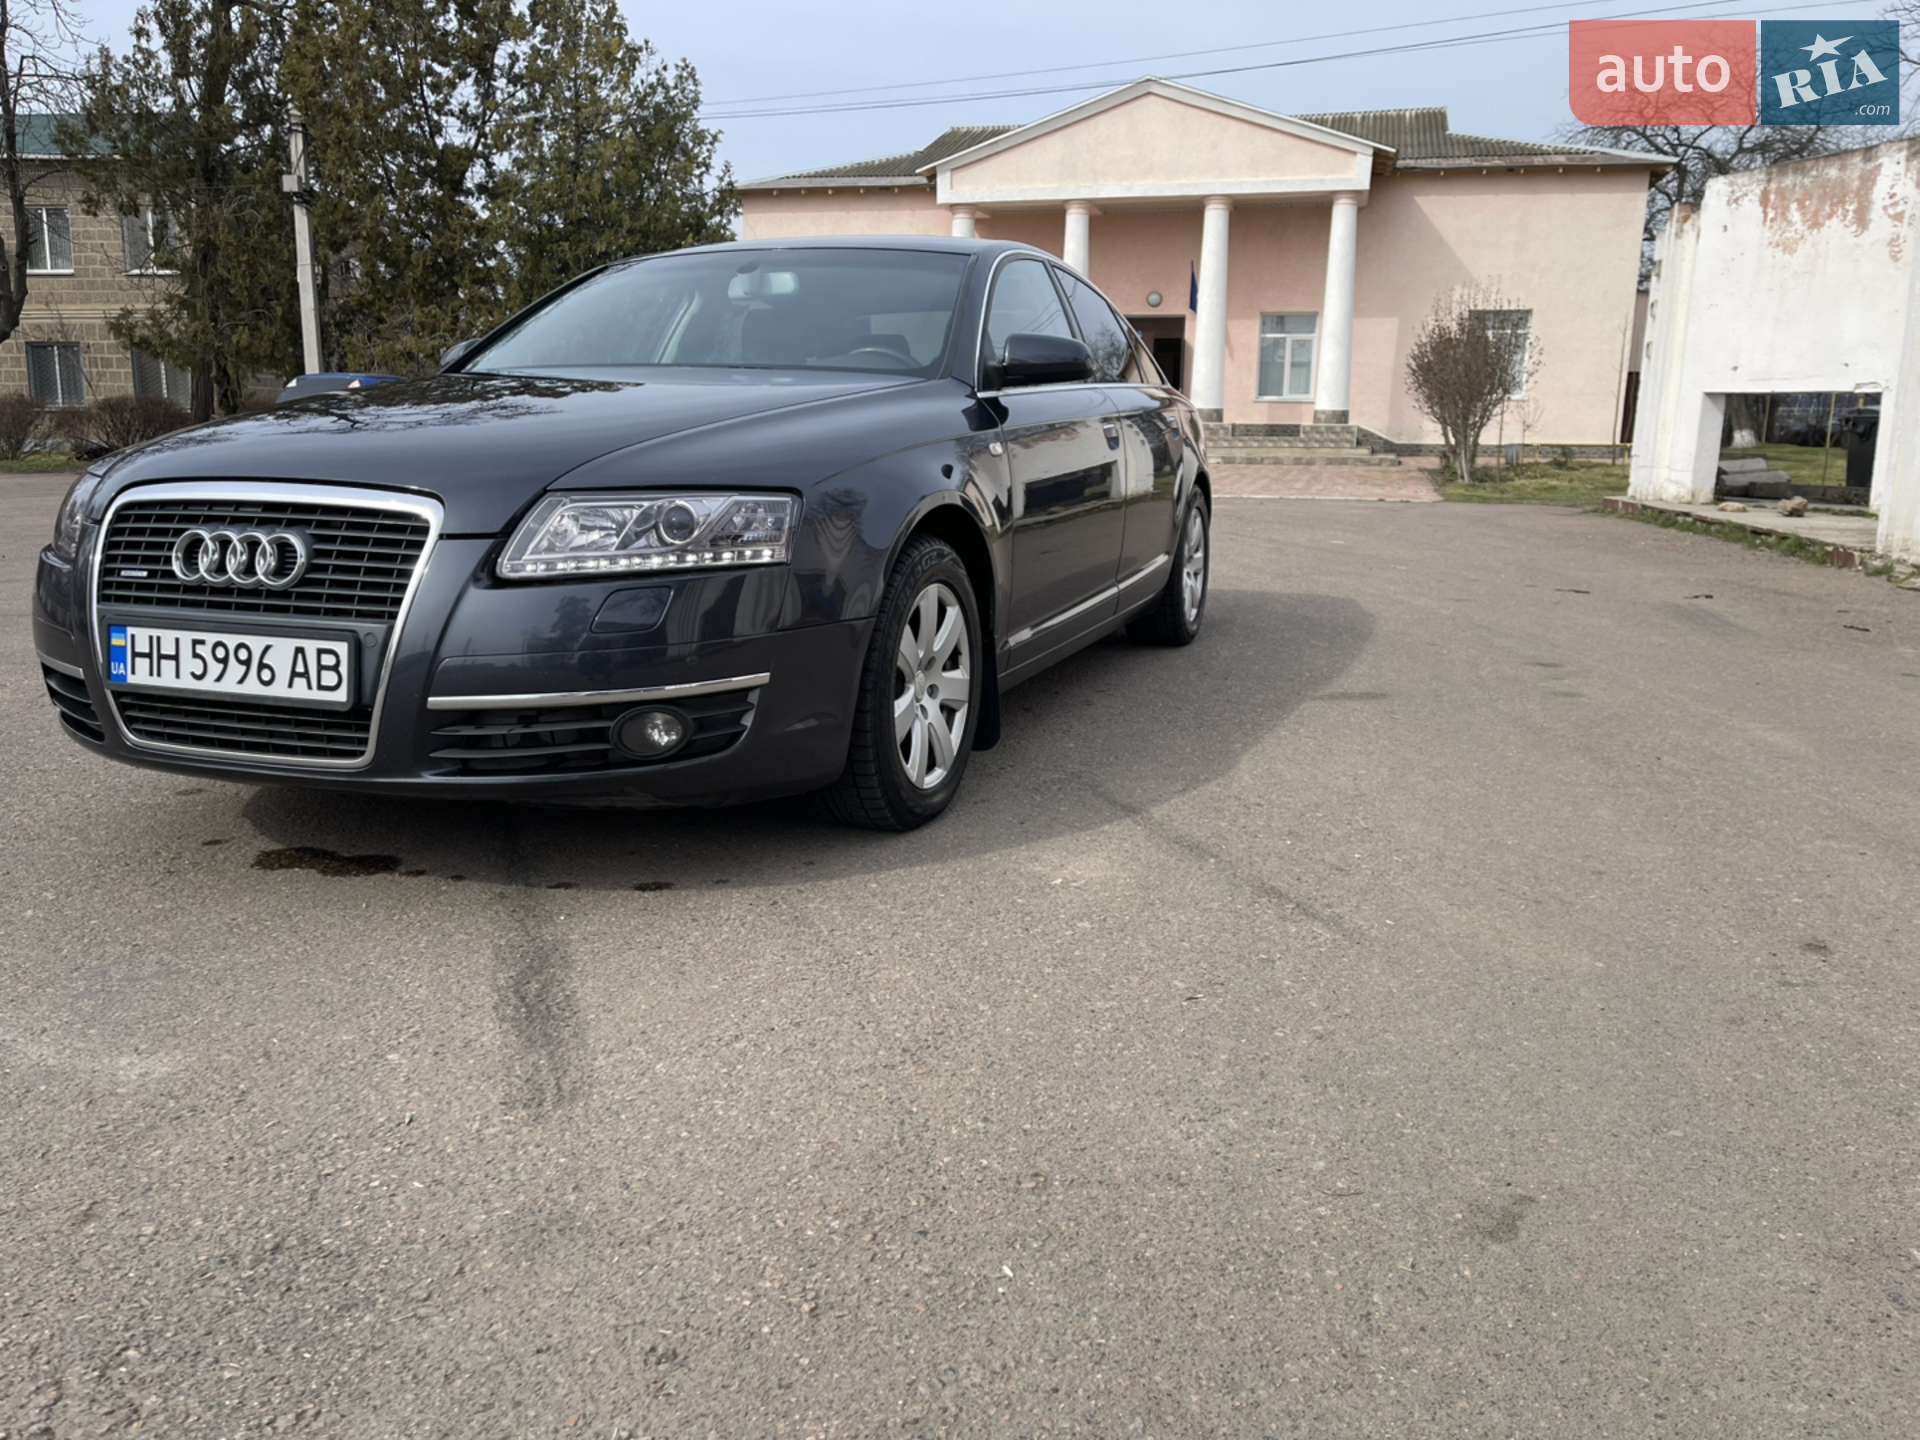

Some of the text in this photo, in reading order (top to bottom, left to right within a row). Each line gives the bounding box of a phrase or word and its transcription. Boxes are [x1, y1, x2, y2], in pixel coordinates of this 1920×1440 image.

[111, 661, 126, 676] UA
[130, 633, 343, 692] HH 5996 AB
